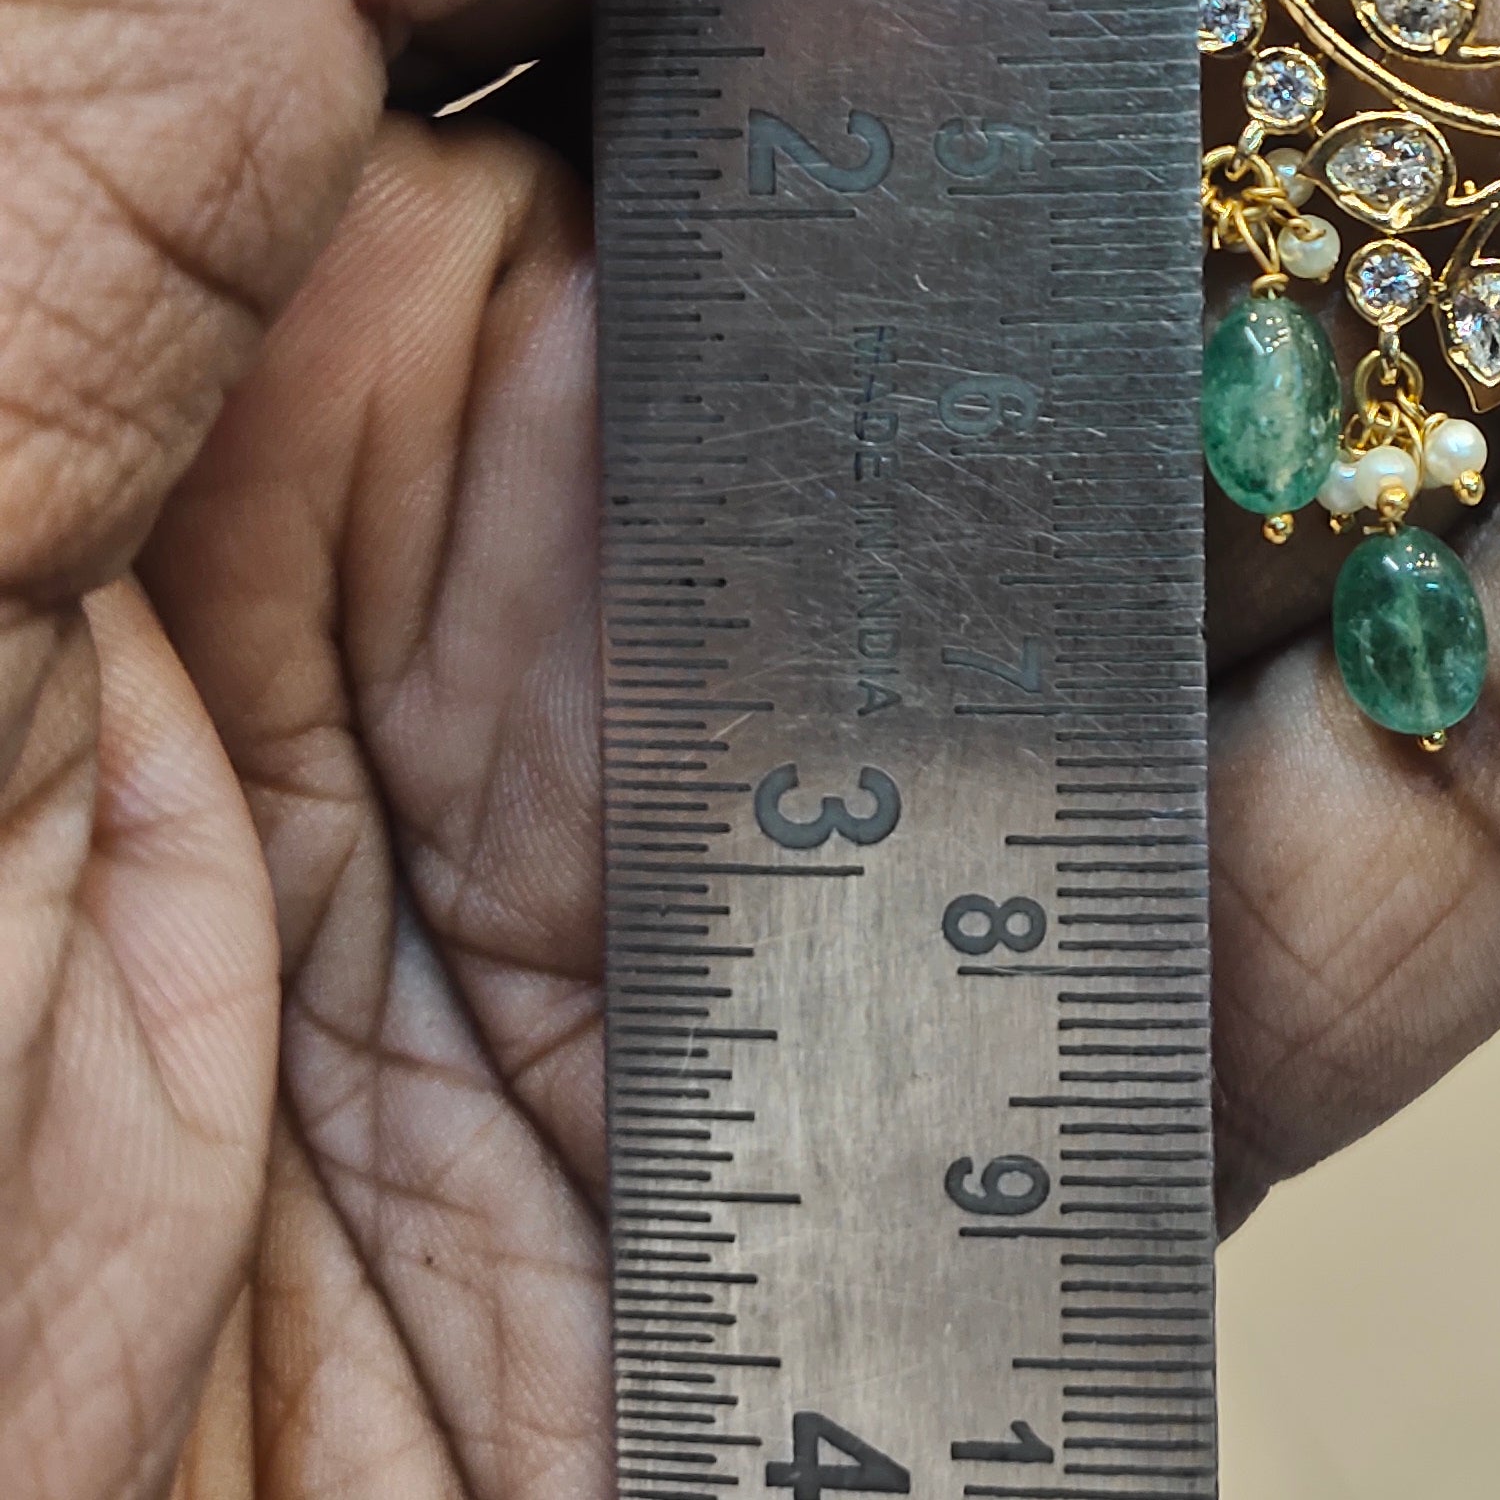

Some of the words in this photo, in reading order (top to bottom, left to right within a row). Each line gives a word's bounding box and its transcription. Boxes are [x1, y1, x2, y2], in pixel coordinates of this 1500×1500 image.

[748, 109, 894, 195] 2
[934, 116, 1039, 178] 5
[853, 325, 899, 482] MADE
[938, 374, 1043, 437] 6
[854, 503, 900, 549] IN
[856, 572, 902, 717] INDIA
[942, 636, 1042, 693] 7
[754, 762, 902, 850] 3
[941, 894, 1047, 955] 8
[944, 1154, 1050, 1216] 9
[766, 1411, 910, 1500] 4
